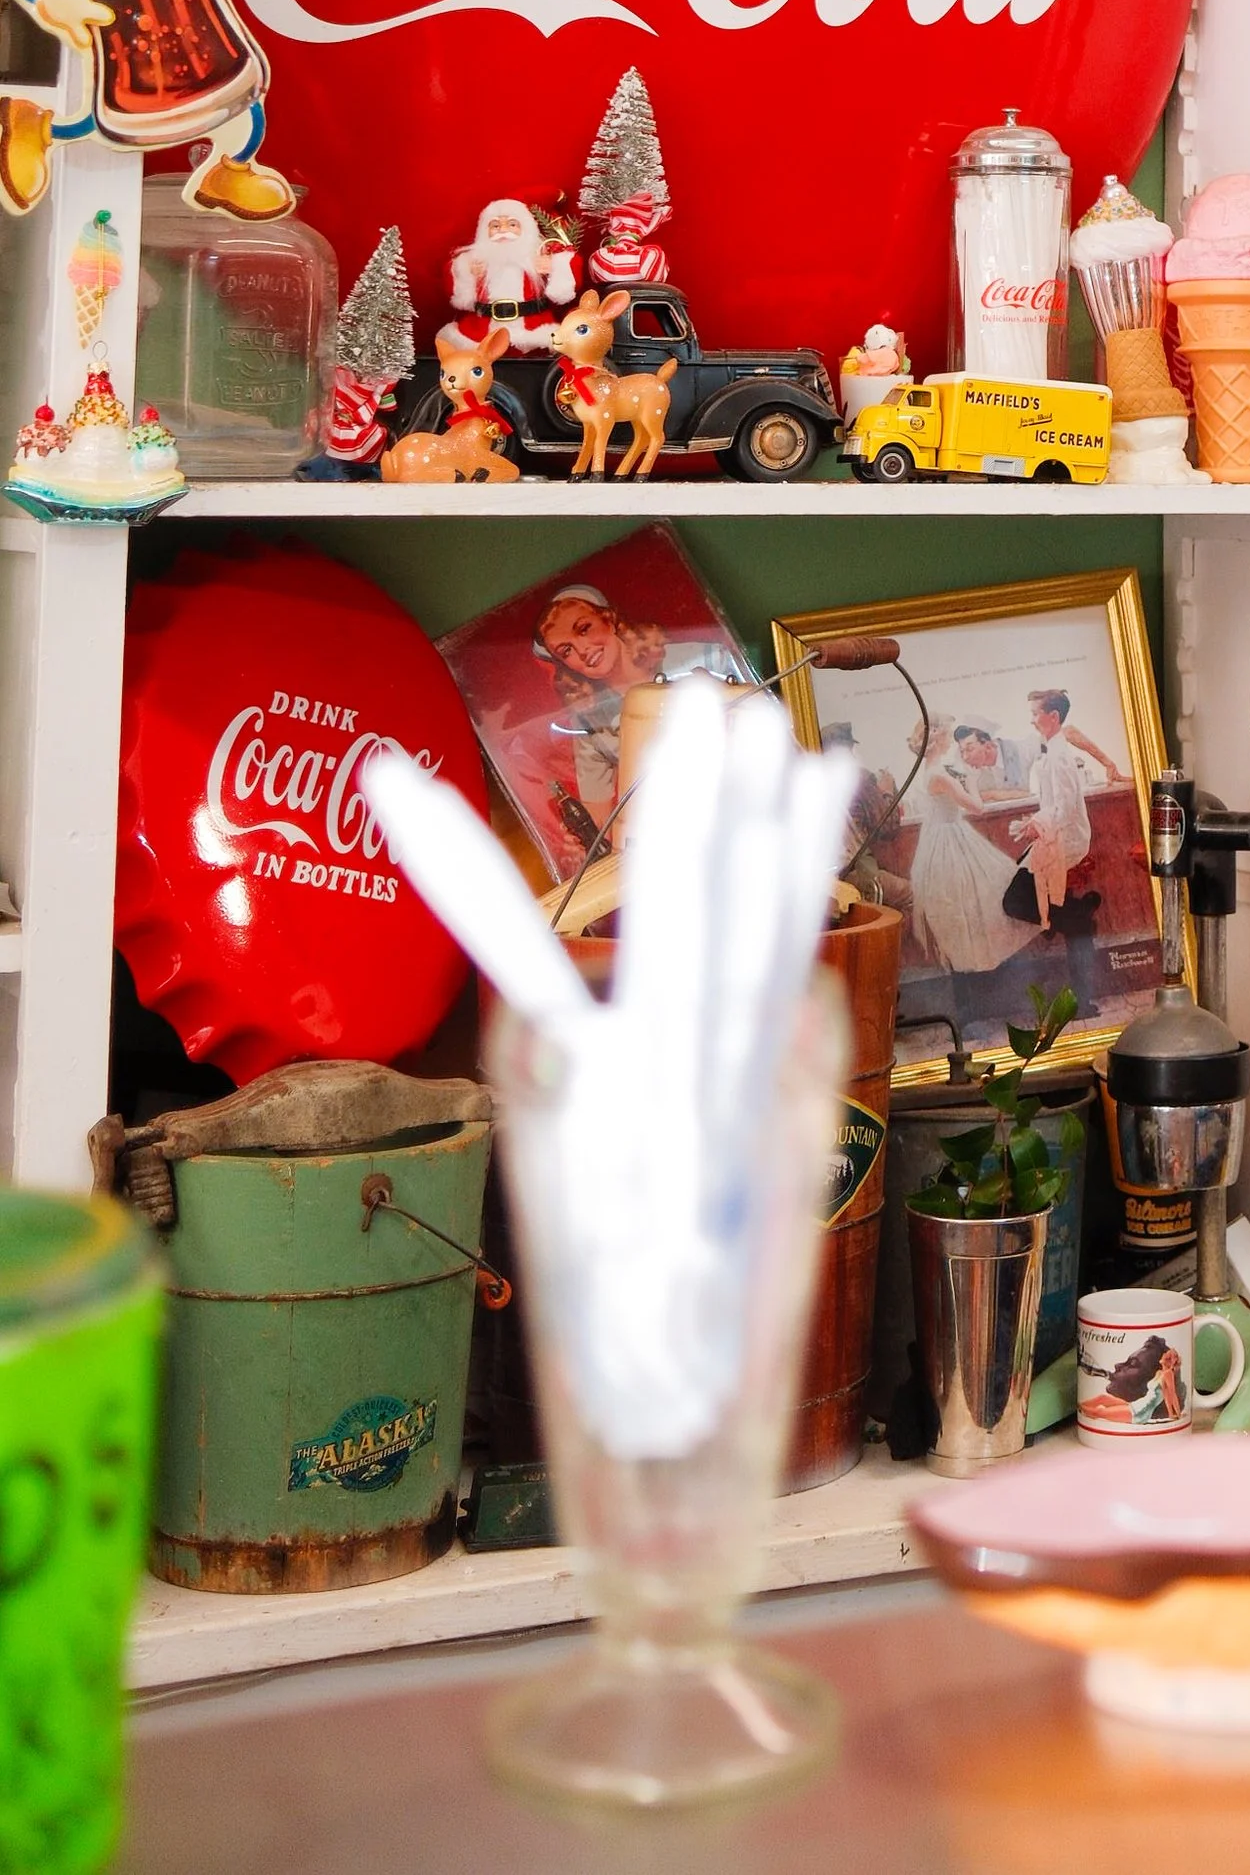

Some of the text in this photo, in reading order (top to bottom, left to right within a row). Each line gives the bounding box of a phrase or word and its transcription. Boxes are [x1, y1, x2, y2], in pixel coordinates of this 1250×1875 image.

[982, 314, 1020, 323] Delicious
[1022, 315, 1037, 323] and
[965, 390, 1040, 411] MAYFIELD'S
[1035, 430, 1104, 449] ICE CREAM
[268, 690, 359, 733] DRINK
[207, 705, 443, 865] Coca-Co
[253, 852, 399, 904] IN BOTTLES
[834, 1125, 878, 1150] UNTAIN
[1081, 1330, 1126, 1344] refreshed
[296, 1445, 319, 1459] THE
